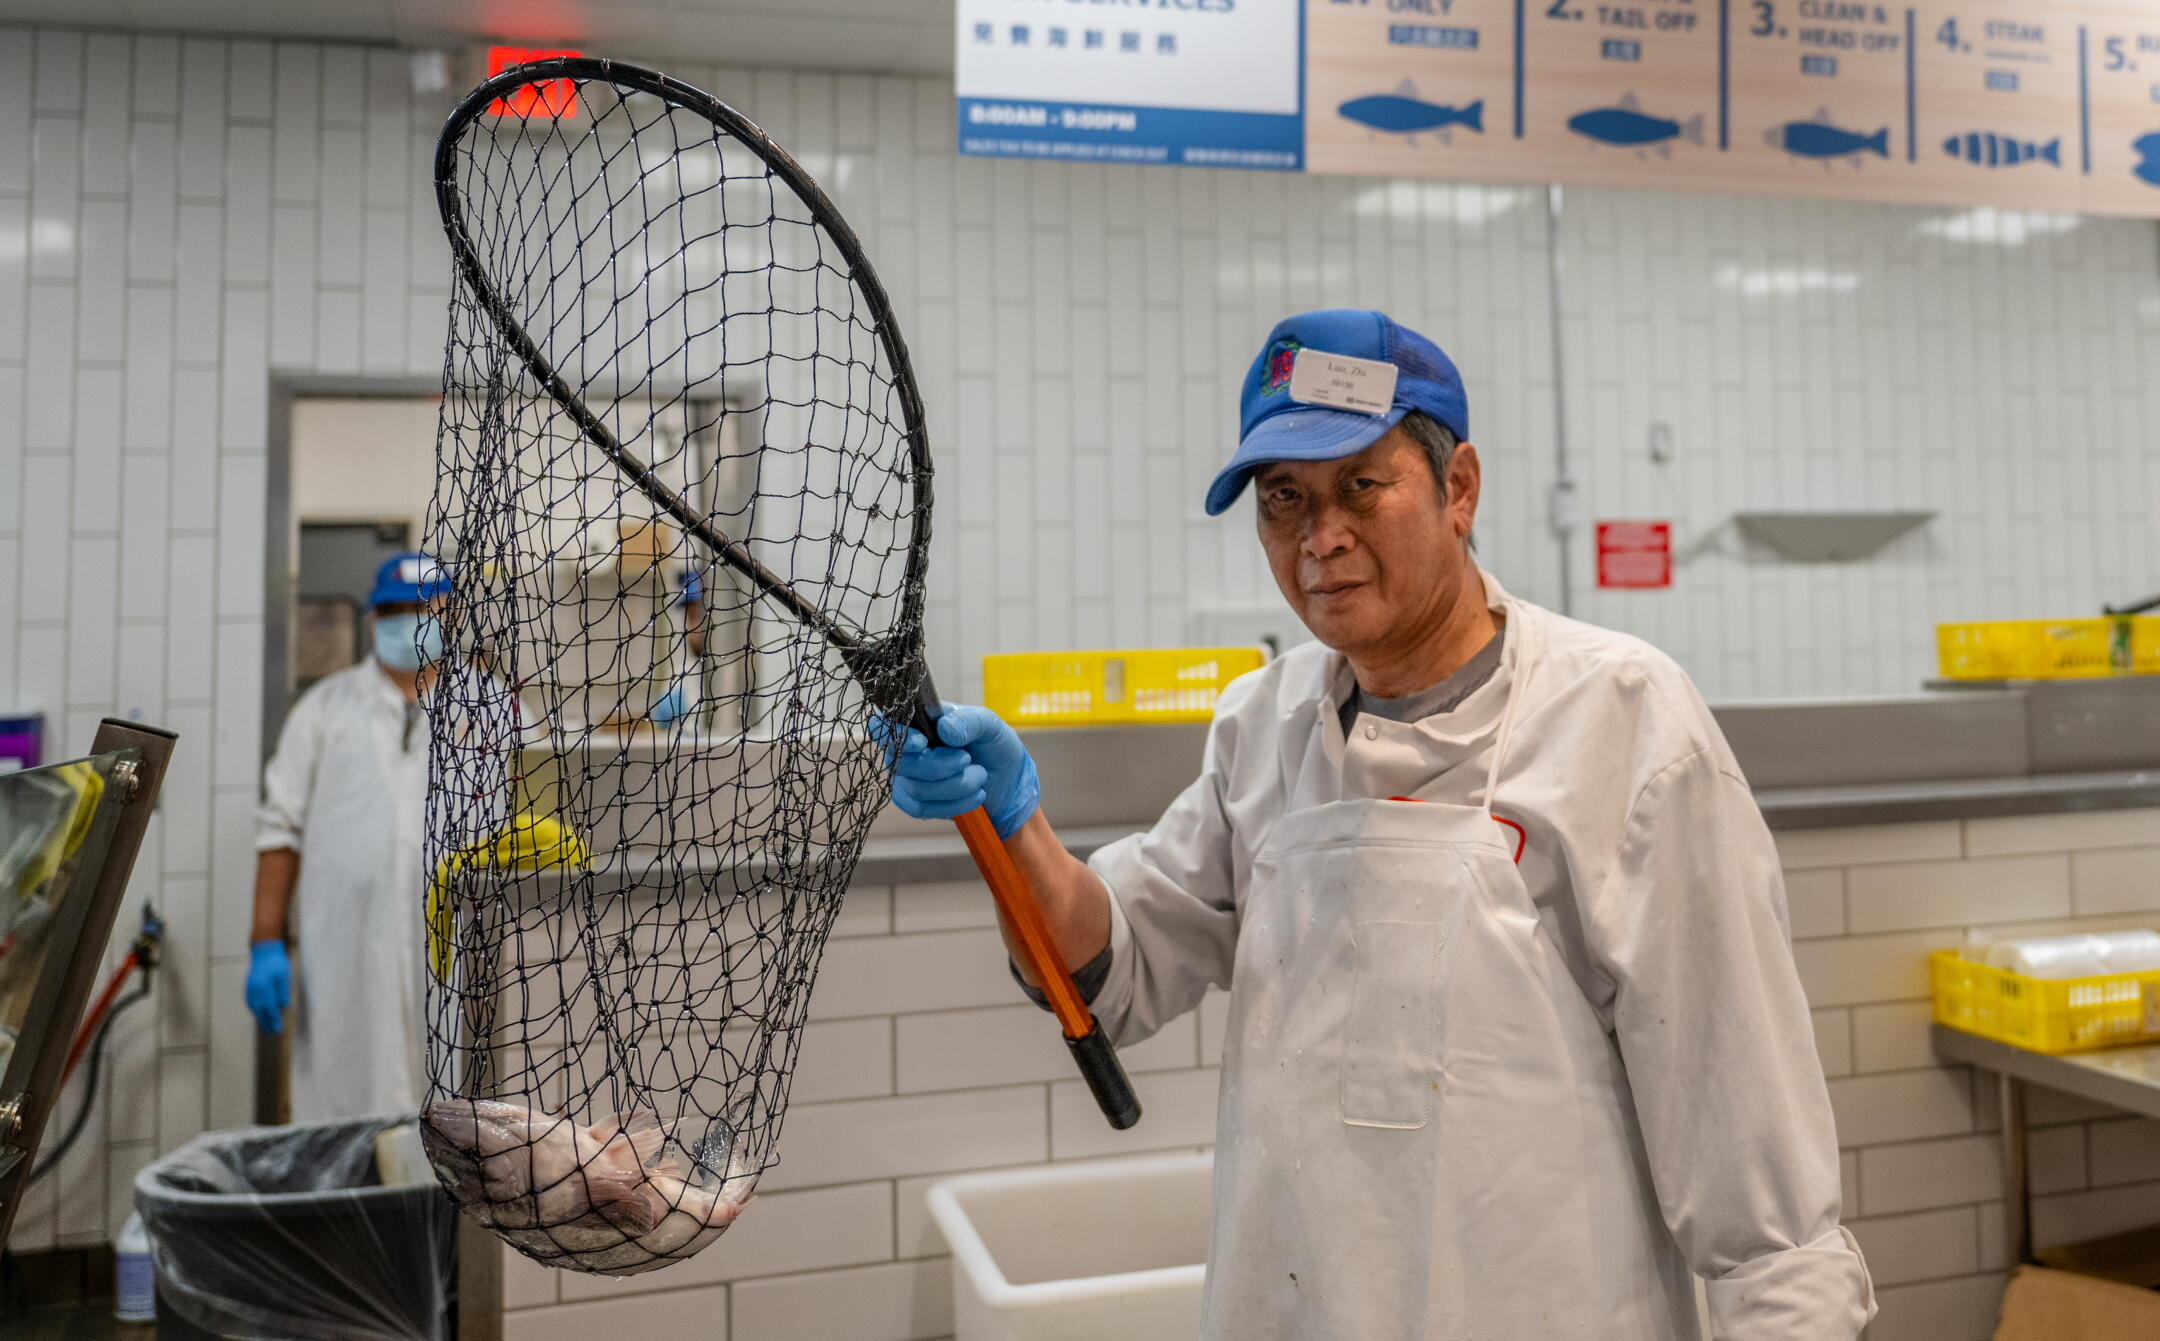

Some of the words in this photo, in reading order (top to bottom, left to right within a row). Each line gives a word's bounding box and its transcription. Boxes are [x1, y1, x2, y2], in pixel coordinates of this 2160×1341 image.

[1598, 6, 1648, 30] TAIL
[1654, 11, 1697, 32] OFF
[1751, 0, 1788, 38] 3.
[1799, 0, 1865, 21] CLEAN
[1799, 28, 1856, 49] HEAD
[1862, 32, 1900, 53] OFF
[1936, 17, 1972, 53] 4.
[1984, 20, 2043, 43] STEAK
[2103, 36, 2138, 72] 5.
